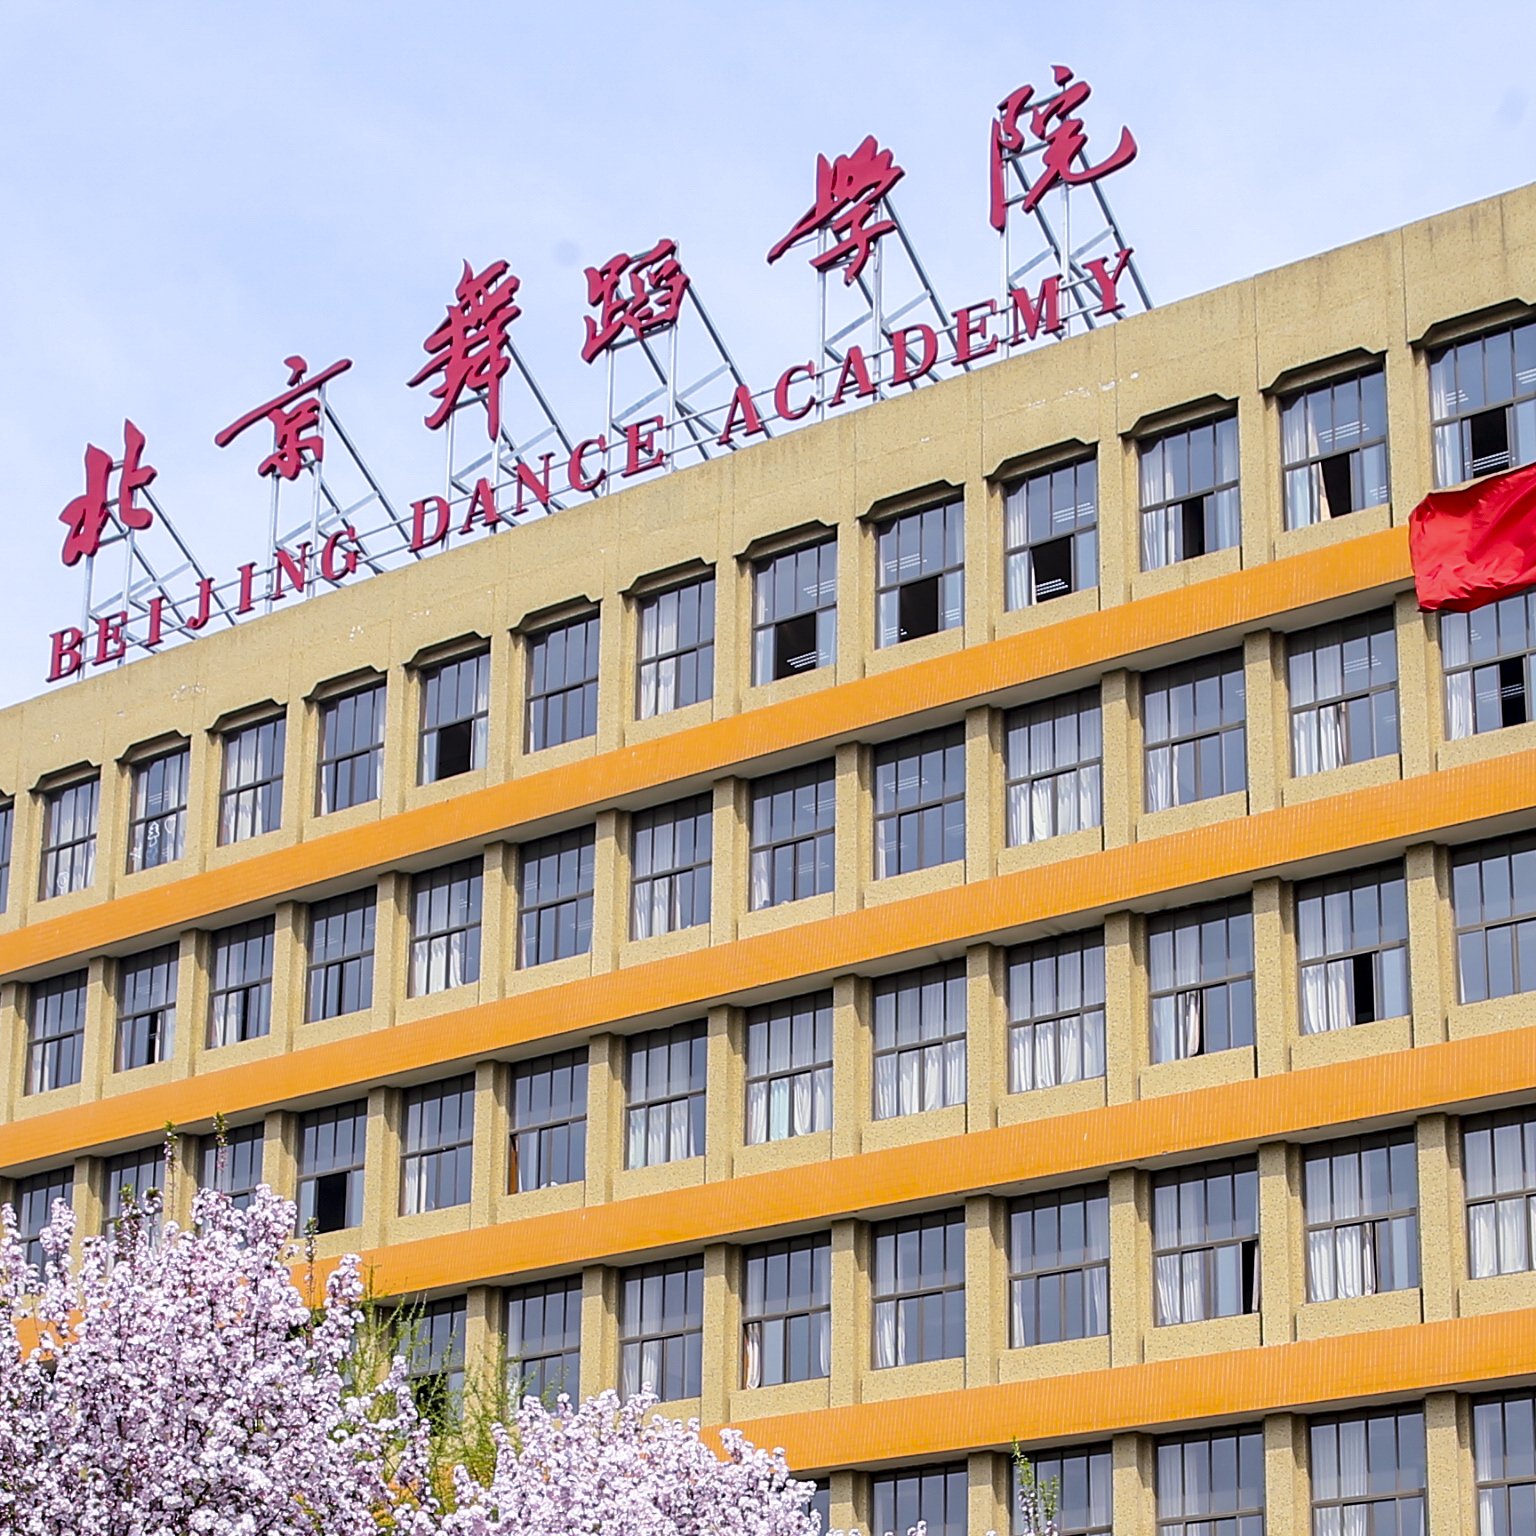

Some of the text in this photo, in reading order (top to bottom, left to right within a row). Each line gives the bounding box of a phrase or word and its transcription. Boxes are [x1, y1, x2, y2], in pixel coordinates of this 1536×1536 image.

[46, 248, 1134, 682] BEIJING DANCE ACADEMY
